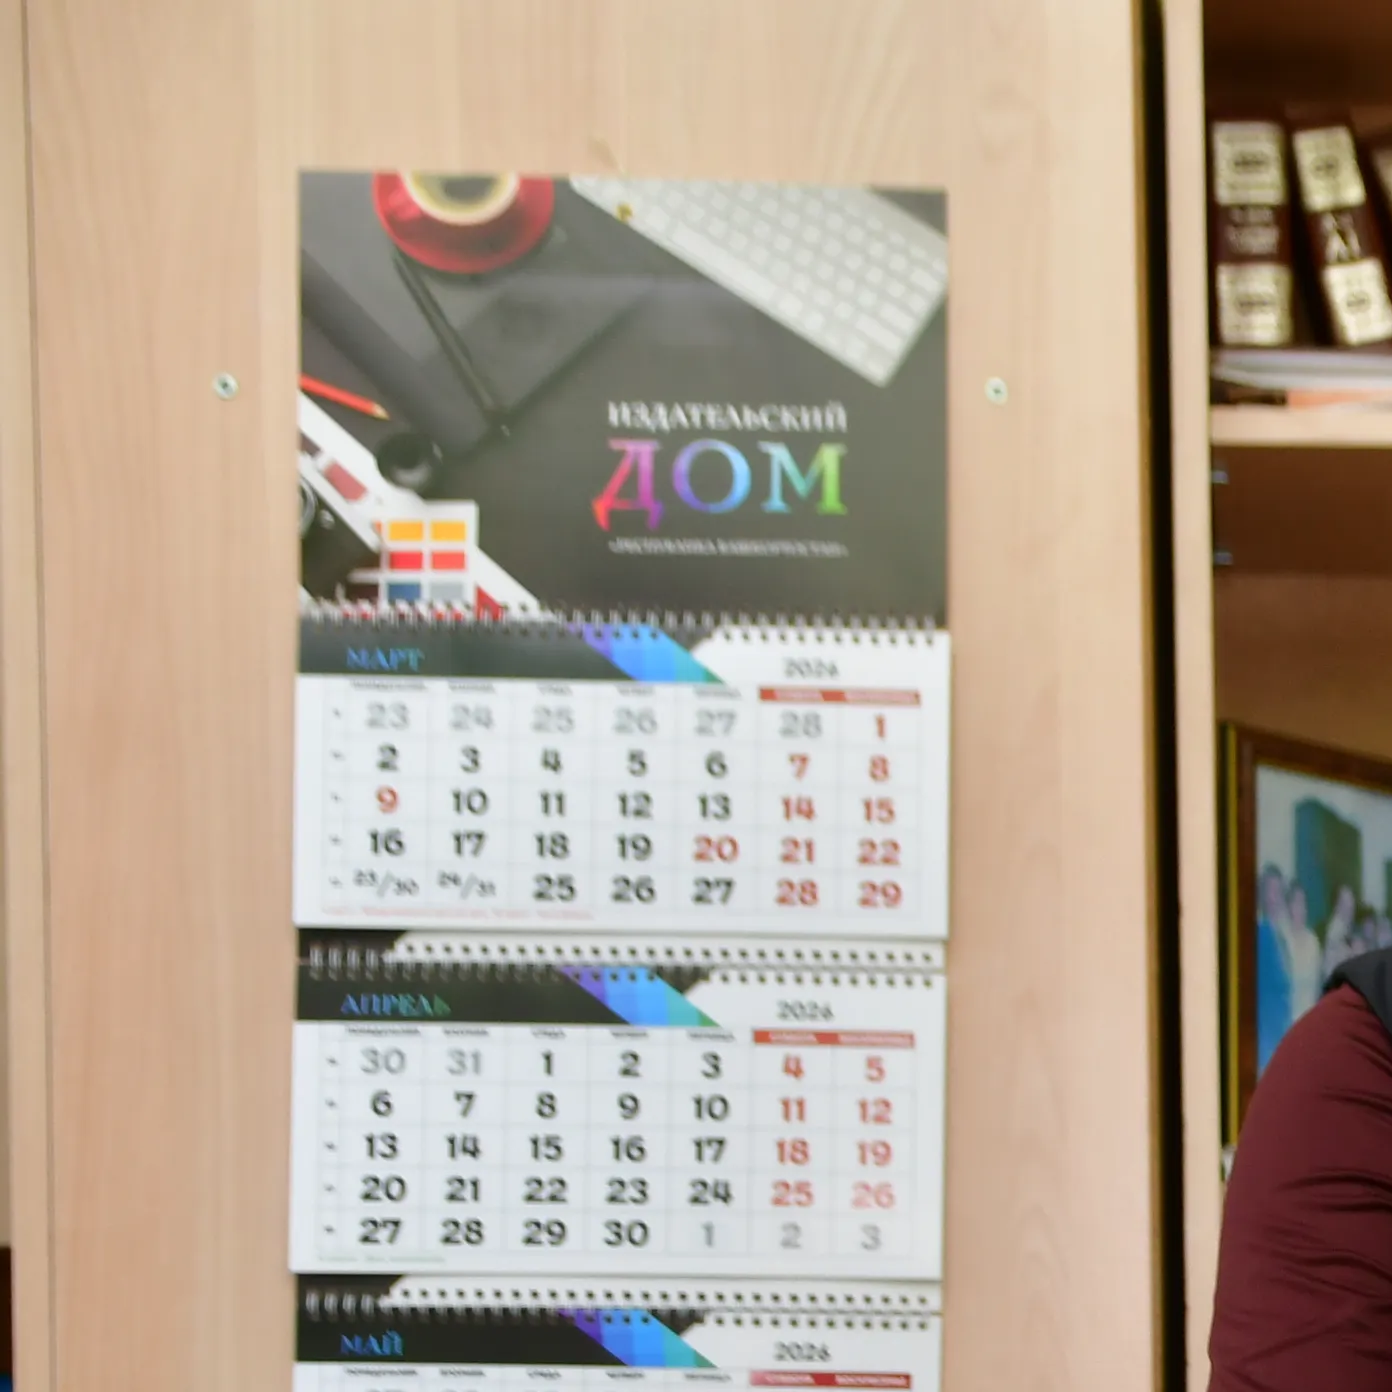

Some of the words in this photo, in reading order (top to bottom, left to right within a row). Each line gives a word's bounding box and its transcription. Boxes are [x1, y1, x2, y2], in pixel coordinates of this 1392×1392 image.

[608, 399, 848, 434] ИЗДАТЕЛЬСКИЙ
[591, 438, 849, 532] ДОМ
[346, 646, 425, 672] МАРТ
[875, 714, 886, 740] 1
[376, 744, 399, 772] 2
[460, 745, 481, 774] 3
[541, 748, 563, 774] 4
[627, 749, 648, 777] 5
[704, 751, 728, 779] 6
[788, 753, 810, 780] 7
[868, 755, 890, 782] 8
[376, 787, 399, 813] 9
[452, 788, 489, 815] 10
[540, 791, 565, 817] 11
[618, 791, 652, 819] 12
[698, 793, 731, 821] 13
[782, 796, 815, 821] 14
[863, 798, 895, 824] 15
[369, 829, 405, 856] 16
[452, 830, 486, 857] 17
[535, 832, 570, 859] 18
[617, 834, 652, 861] 19
[693, 836, 739, 862] 20
[780, 837, 814, 864] 21
[857, 839, 900, 866] 22
[533, 874, 576, 902] 25
[611, 876, 656, 903] 26
[692, 877, 735, 904] 27
[775, 879, 819, 906] 28
[858, 881, 902, 908] 29
[340, 993, 451, 1017] АПРЕЛЬ
[541, 1050, 554, 1076] 1
[618, 1050, 640, 1078] 2
[701, 1052, 722, 1080] 3
[782, 1054, 804, 1080] 4
[865, 1055, 886, 1083] 5
[370, 1090, 393, 1117] 6
[454, 1091, 477, 1118] 7
[536, 1092, 557, 1119] 8
[617, 1093, 640, 1120] 9
[693, 1094, 730, 1121] 10
[780, 1097, 805, 1123] 11
[858, 1098, 892, 1125] 12
[365, 1133, 398, 1160] 13
[446, 1134, 481, 1160] 14
[529, 1135, 563, 1162] 15
[611, 1136, 646, 1162] 16
[693, 1137, 726, 1163] 17
[776, 1139, 809, 1166] 18
[857, 1140, 892, 1167] 19
[360, 1176, 406, 1202] 20
[445, 1176, 480, 1203] 21
[523, 1177, 567, 1204] 22
[605, 1178, 648, 1205] 23
[689, 1179, 733, 1205] 24
[771, 1180, 813, 1207] 25
[852, 1181, 895, 1209] 26
[359, 1218, 402, 1244] 27
[440, 1219, 484, 1245] 28
[522, 1219, 567, 1246] 29
[604, 1220, 649, 1247] 30
[340, 1328, 403, 1356] МАЙ
